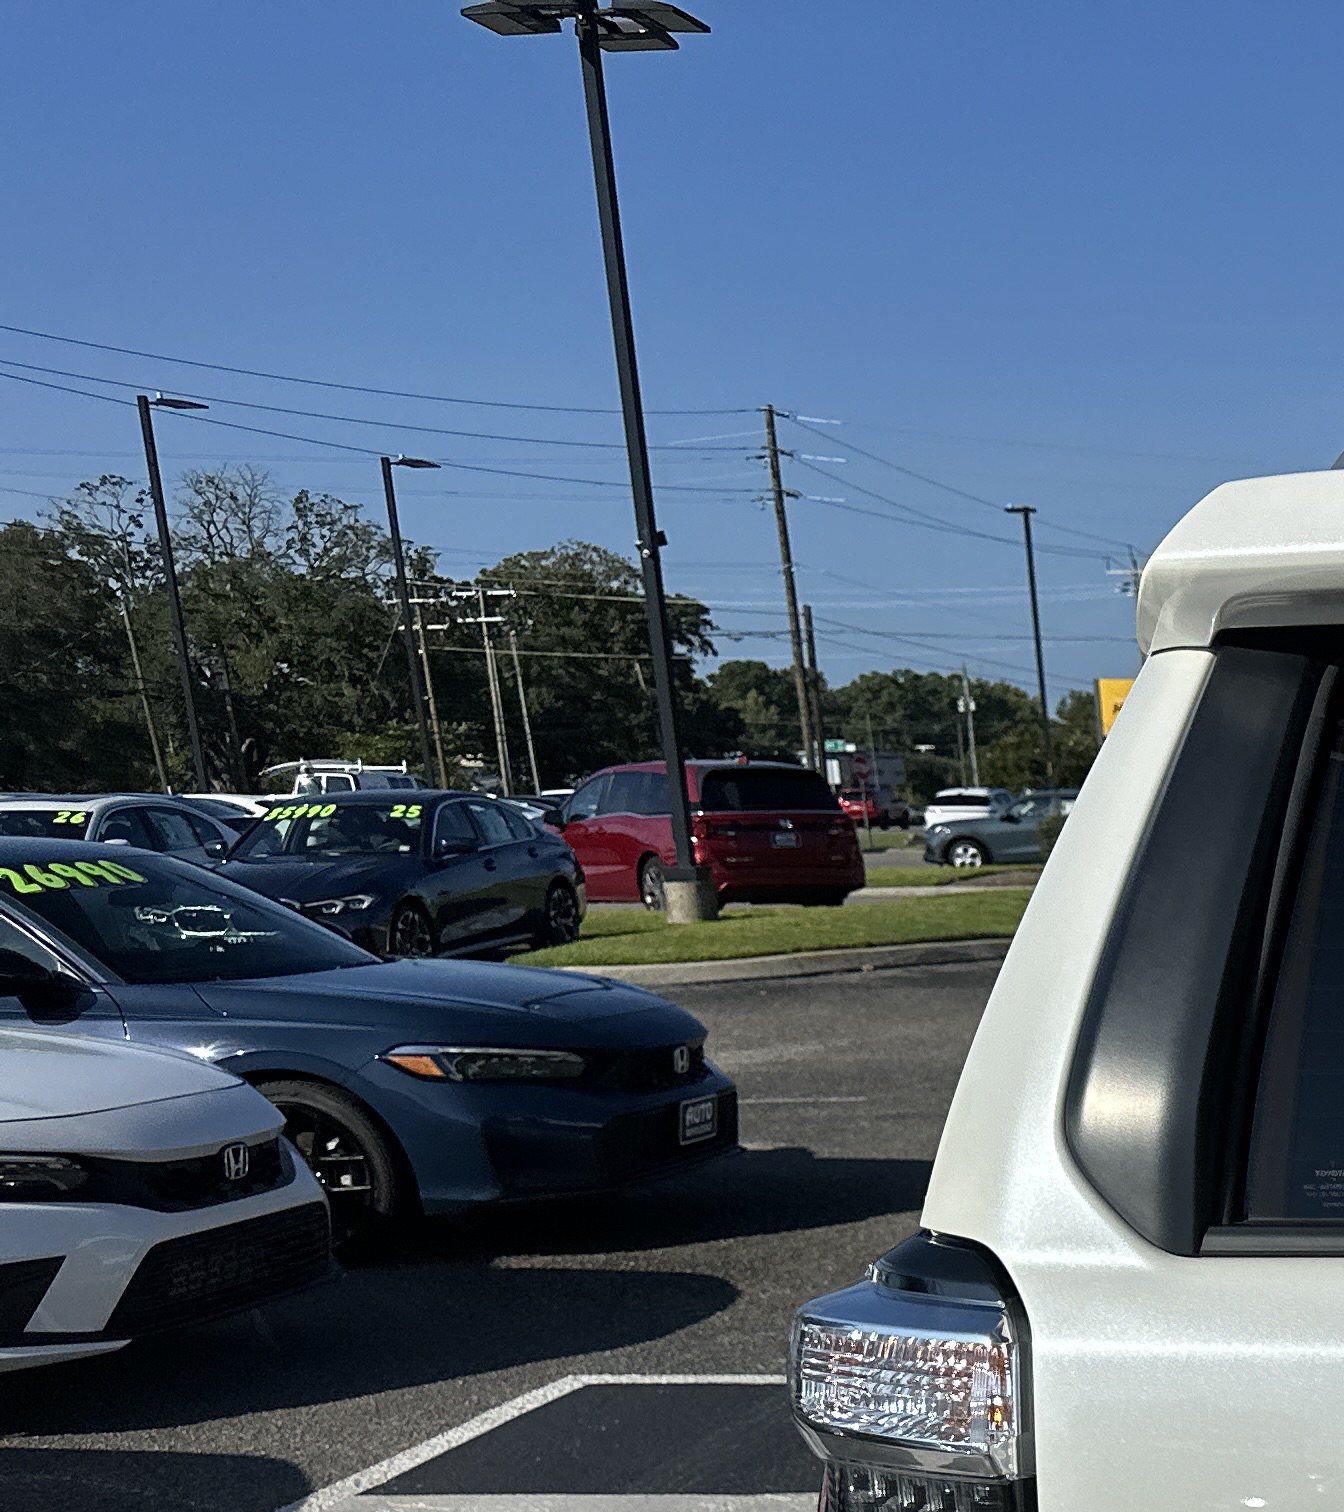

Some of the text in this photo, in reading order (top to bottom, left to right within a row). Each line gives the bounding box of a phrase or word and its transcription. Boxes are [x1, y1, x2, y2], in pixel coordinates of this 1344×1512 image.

[52, 811, 87, 824] 26
[389, 804, 423, 818] 25
[0, 859, 146, 893] 26990
